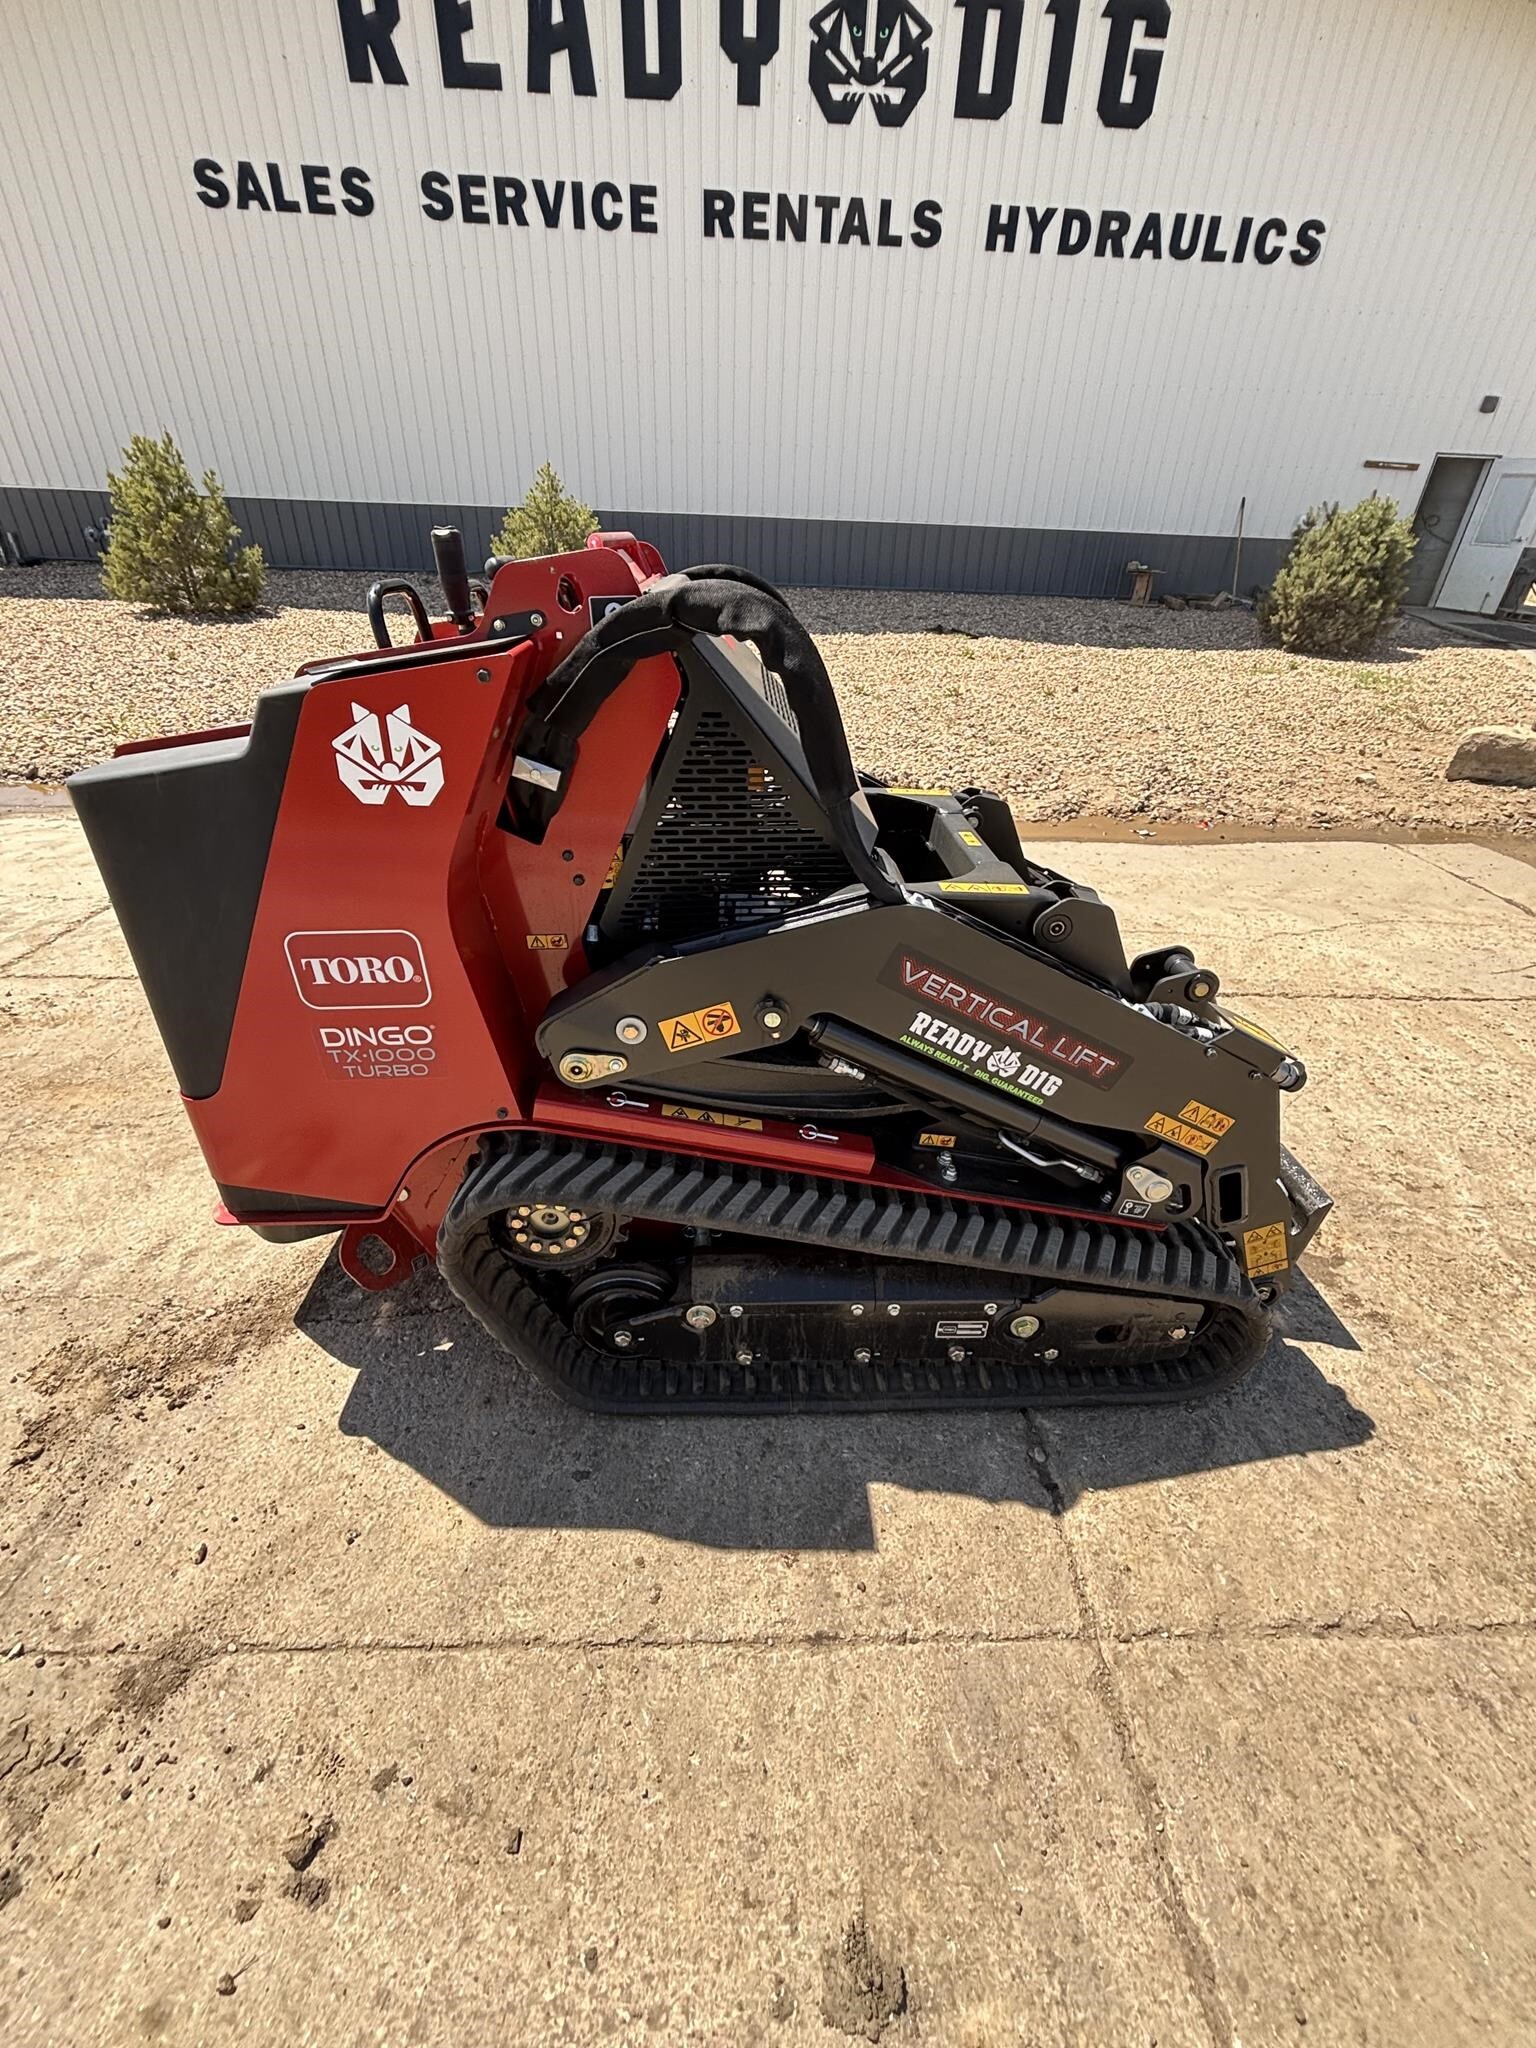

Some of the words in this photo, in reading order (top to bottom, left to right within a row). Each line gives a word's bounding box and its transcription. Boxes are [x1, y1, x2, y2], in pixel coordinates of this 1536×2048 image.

[193, 158, 375, 218] SALES
[421, 170, 658, 234] SERVICE
[703, 188, 943, 249] RENTALS
[984, 204, 1327, 267] HYDRAULICS
[319, 1026, 433, 1048] DINGO
[903, 959, 1046, 1049] VERTICAL
[1052, 1037, 1116, 1077] LIFT
[908, 1010, 993, 1063] READY
[1016, 1063, 1063, 1097] DIG
[343, 1063, 429, 1078] TURBO
[899, 1034, 934, 1056] ALWAYS
[933, 1049, 964, 1068] READY
[990, 1076, 1045, 1106] GUARANTEED
